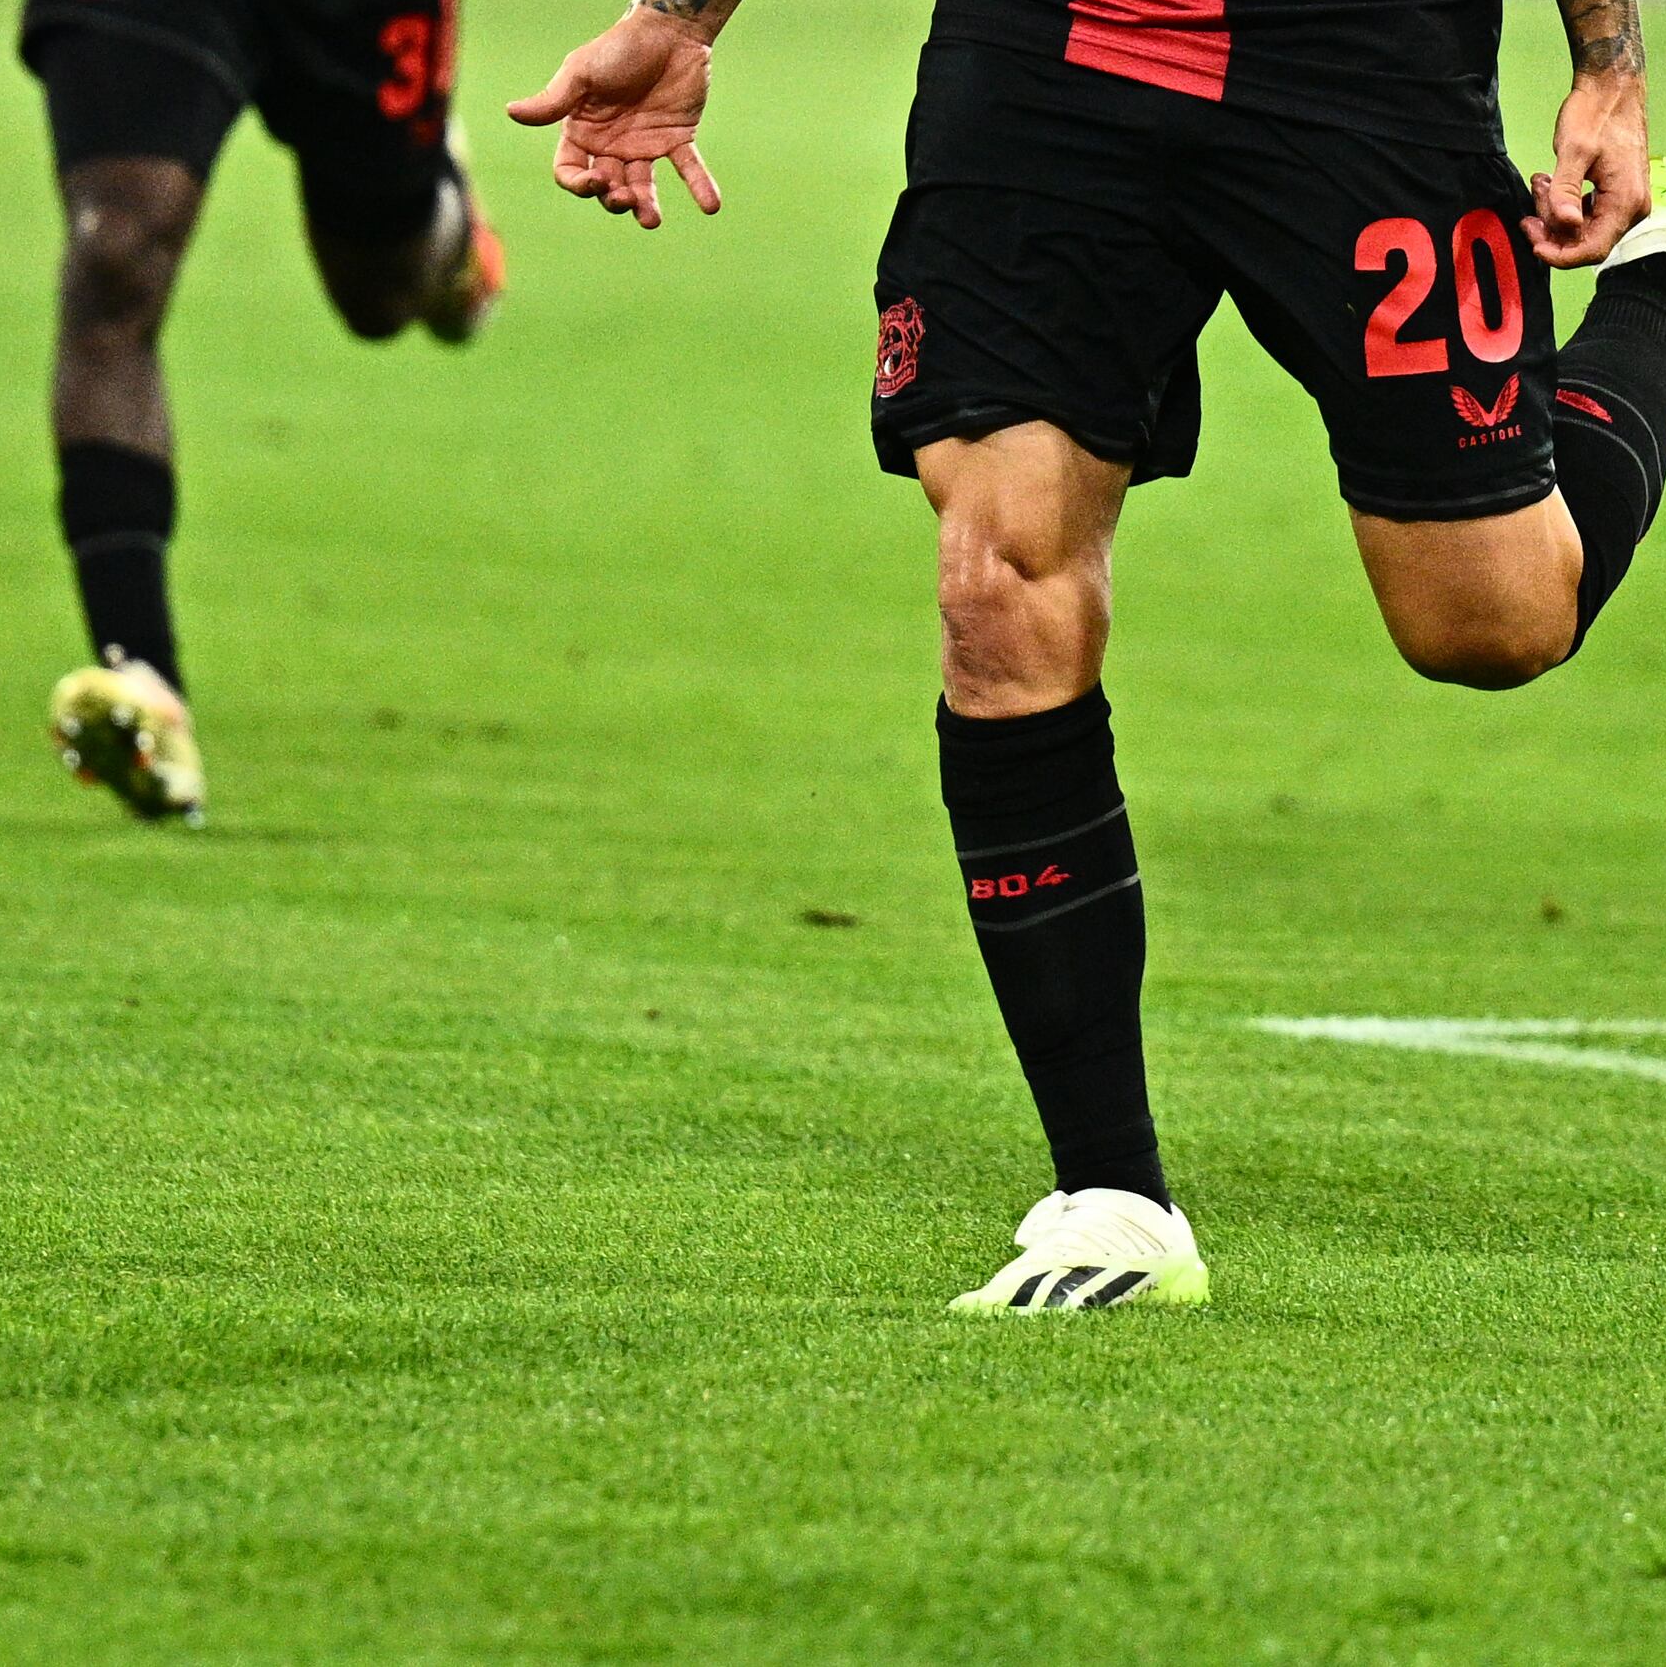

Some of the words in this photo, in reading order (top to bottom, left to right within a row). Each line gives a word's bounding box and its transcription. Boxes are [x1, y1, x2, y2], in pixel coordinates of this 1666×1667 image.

[1353, 207, 1525, 378] 20
[1458, 424, 1523, 449] CASTORE
[971, 863, 1073, 899] B04
